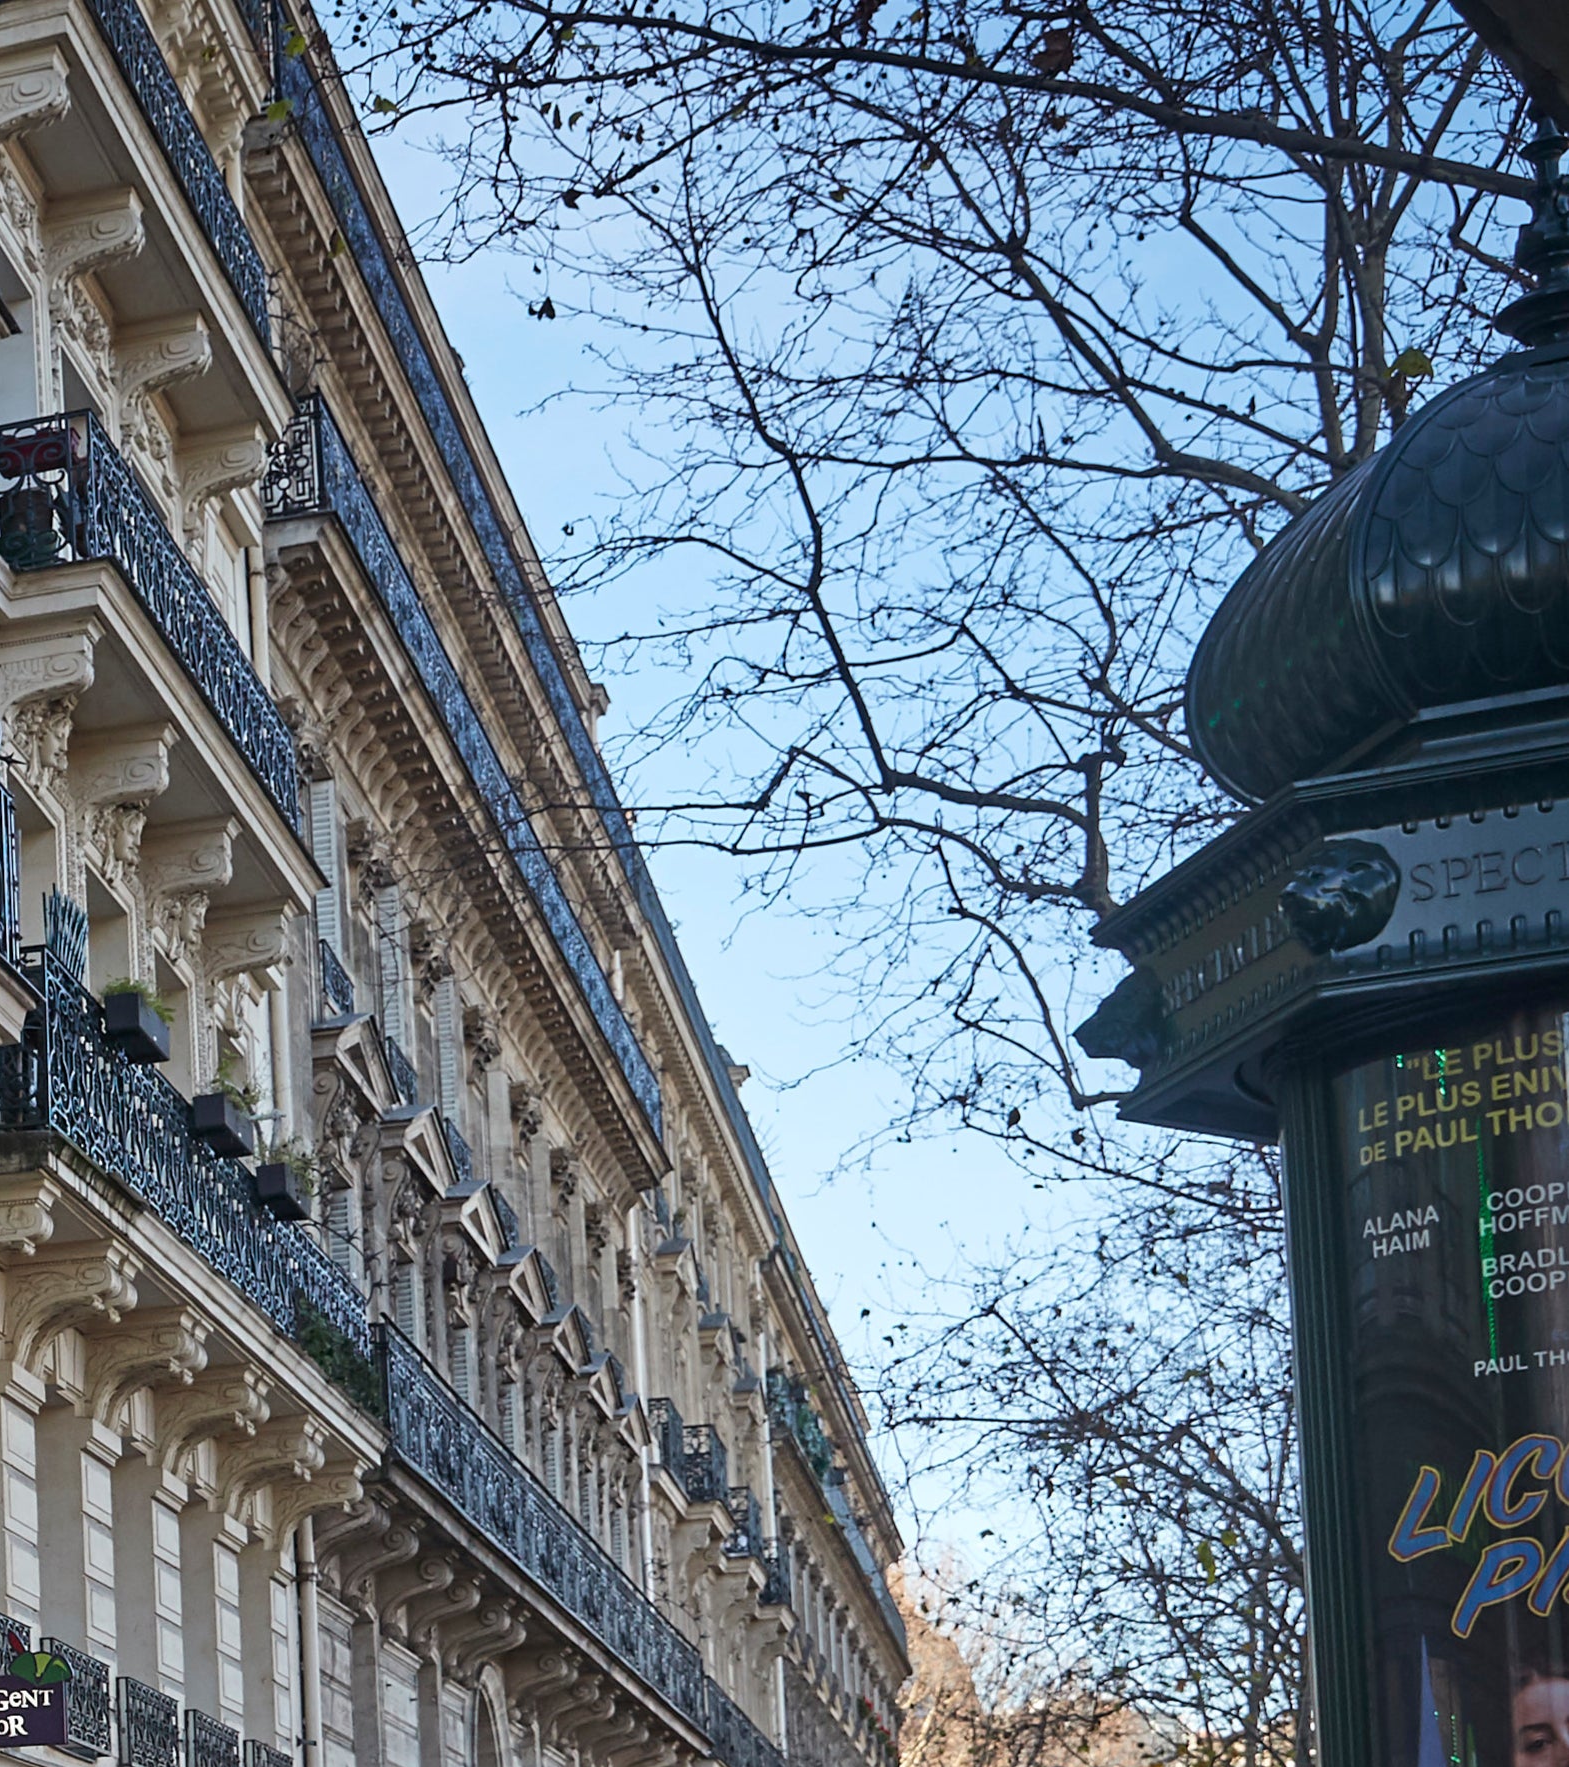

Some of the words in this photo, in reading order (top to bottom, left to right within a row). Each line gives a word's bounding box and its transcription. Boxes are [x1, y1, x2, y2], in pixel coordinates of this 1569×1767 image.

[1473, 1030, 1563, 1070] PLUS
[1359, 1101, 1389, 1132] LE
[1397, 1080, 1482, 1121] PLUS
[1360, 1140, 1387, 1166] DE
[1395, 1117, 1479, 1157] PAUL
[1485, 1102, 1564, 1137] THO
[1486, 1182, 1569, 1212] COOP
[1362, 1204, 1440, 1238] ALANA
[1372, 1229, 1430, 1258] HAIM
[1488, 1271, 1569, 1299] COOP
[1473, 1355, 1528, 1378] PAUL
[1533, 1349, 1569, 1368] TH
